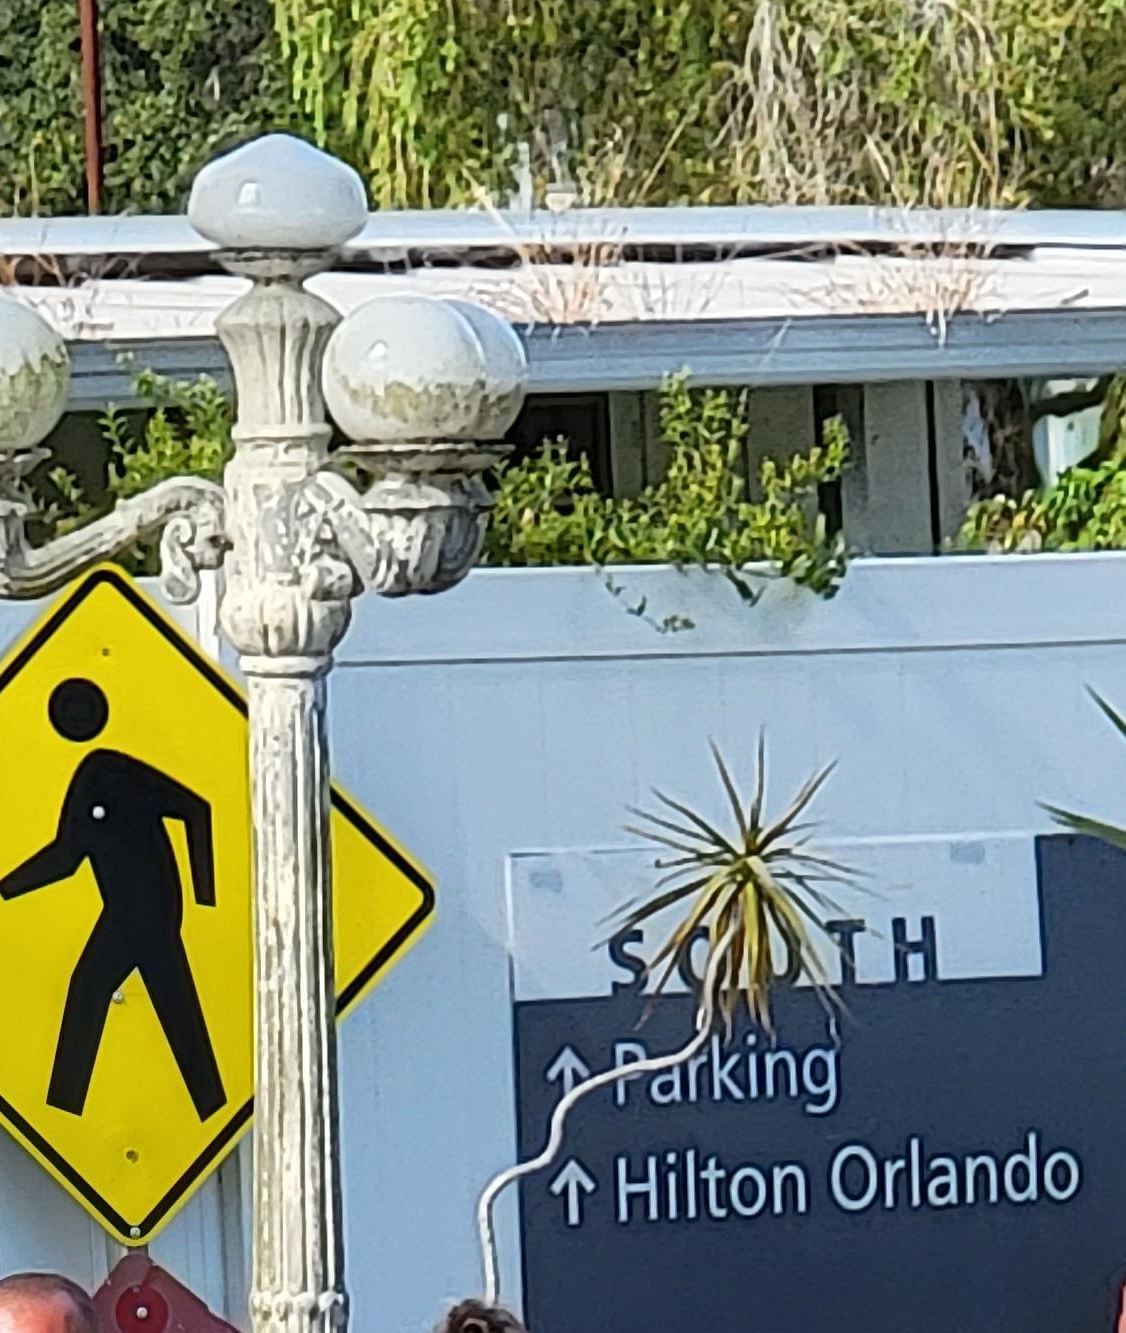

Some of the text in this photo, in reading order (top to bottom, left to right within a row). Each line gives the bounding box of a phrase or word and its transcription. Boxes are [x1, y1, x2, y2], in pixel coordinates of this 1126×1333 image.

[613, 1034, 838, 1114] Parking
[617, 1132, 1080, 1222] Hilton Orlando
